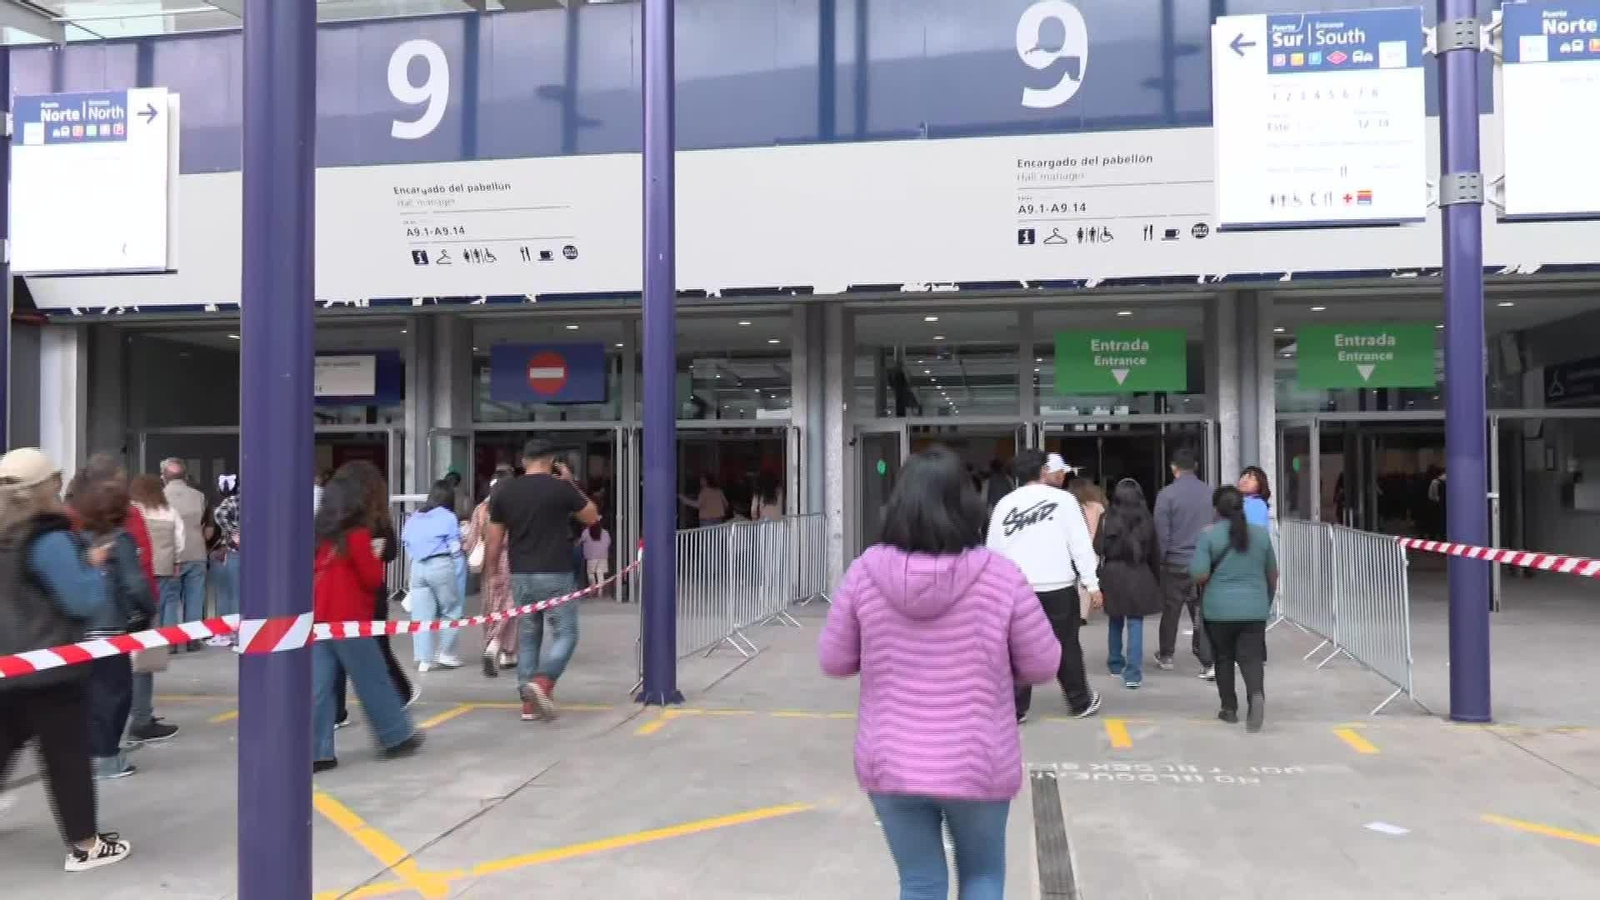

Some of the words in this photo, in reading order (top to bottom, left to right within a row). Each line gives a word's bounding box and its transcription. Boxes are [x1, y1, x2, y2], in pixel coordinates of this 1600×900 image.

[1543, 18, 1598, 34] Norte
[1272, 31, 1304, 47] Sur
[1316, 27, 1366, 45] South
[1016, 0, 1088, 108] 9
[387, 38, 450, 140] 9
[40, 108, 80, 121] Norte
[88, 105, 124, 120] North
[1017, 157, 1077, 169] Encargado
[1081, 156, 1098, 166] del
[449, 183, 464, 193] del
[1091, 338, 1149, 351] Entrada
[1334, 333, 1396, 347] Entrada
[1094, 356, 1147, 367] Entrance
[1338, 350, 1394, 361] Entrance
